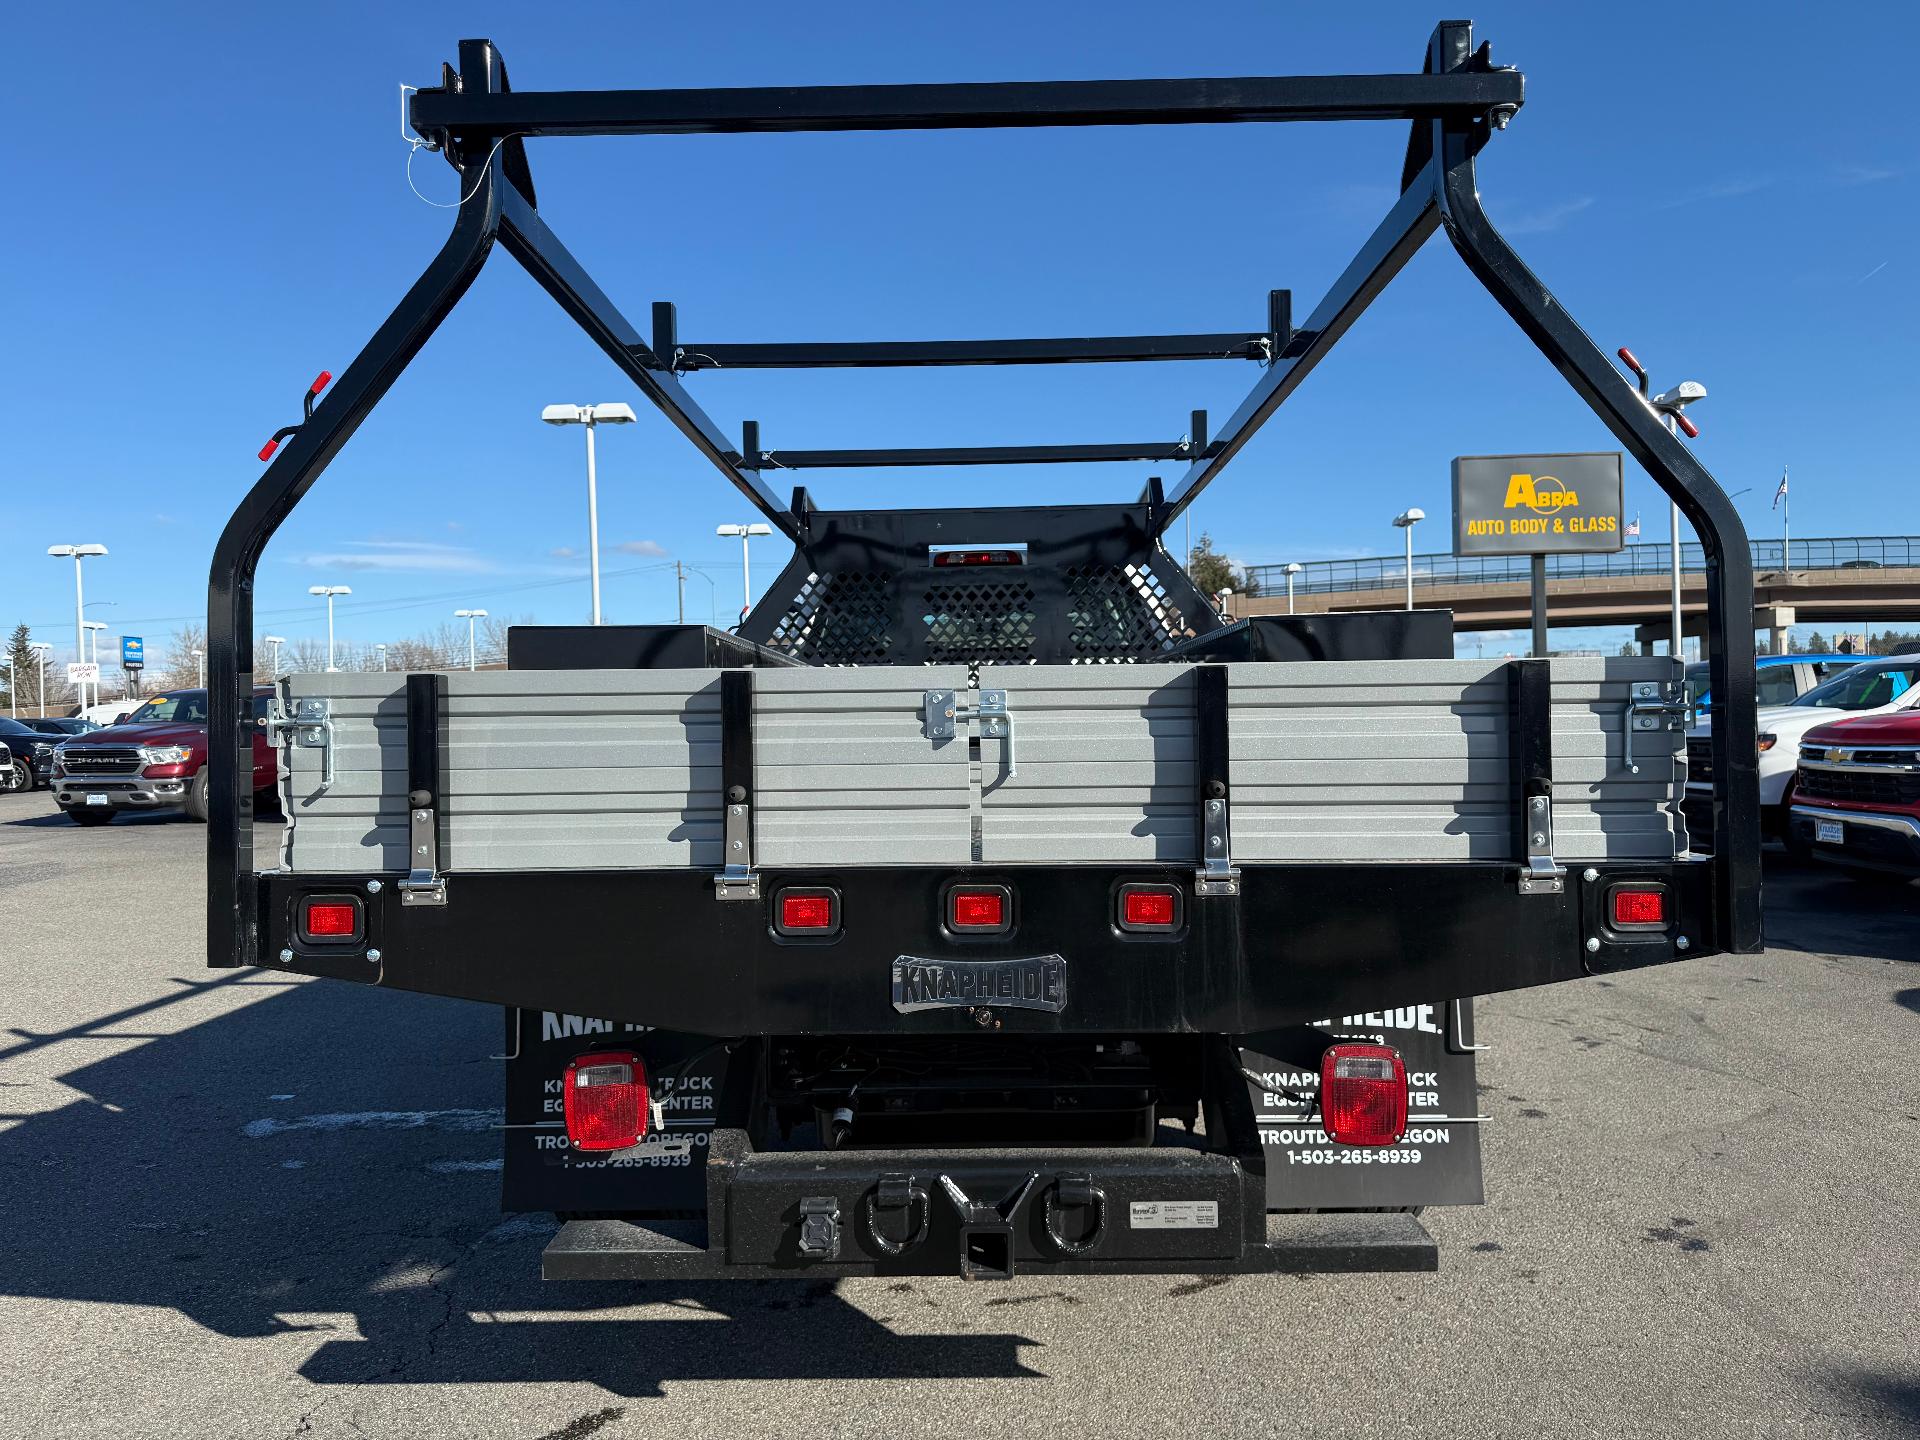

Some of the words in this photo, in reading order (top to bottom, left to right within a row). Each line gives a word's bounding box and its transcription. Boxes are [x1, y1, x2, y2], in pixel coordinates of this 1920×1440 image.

[1504, 473, 1579, 508] ABRA
[1467, 519, 1505, 536] AUTO
[1510, 518, 1549, 534] BODY
[1553, 517, 1564, 533] &
[1569, 516, 1616, 533] GLASS
[900, 963, 1058, 1004] KNAPHEIDE
[1262, 1072, 1320, 1086] KNAPH
[661, 1096, 713, 1110] ENTER
[1408, 1092, 1439, 1106] TER
[1258, 1129, 1334, 1144] TROUTD
[1400, 1128, 1449, 1144] EGON
[1287, 1149, 1422, 1165] 1-503-265-8939
